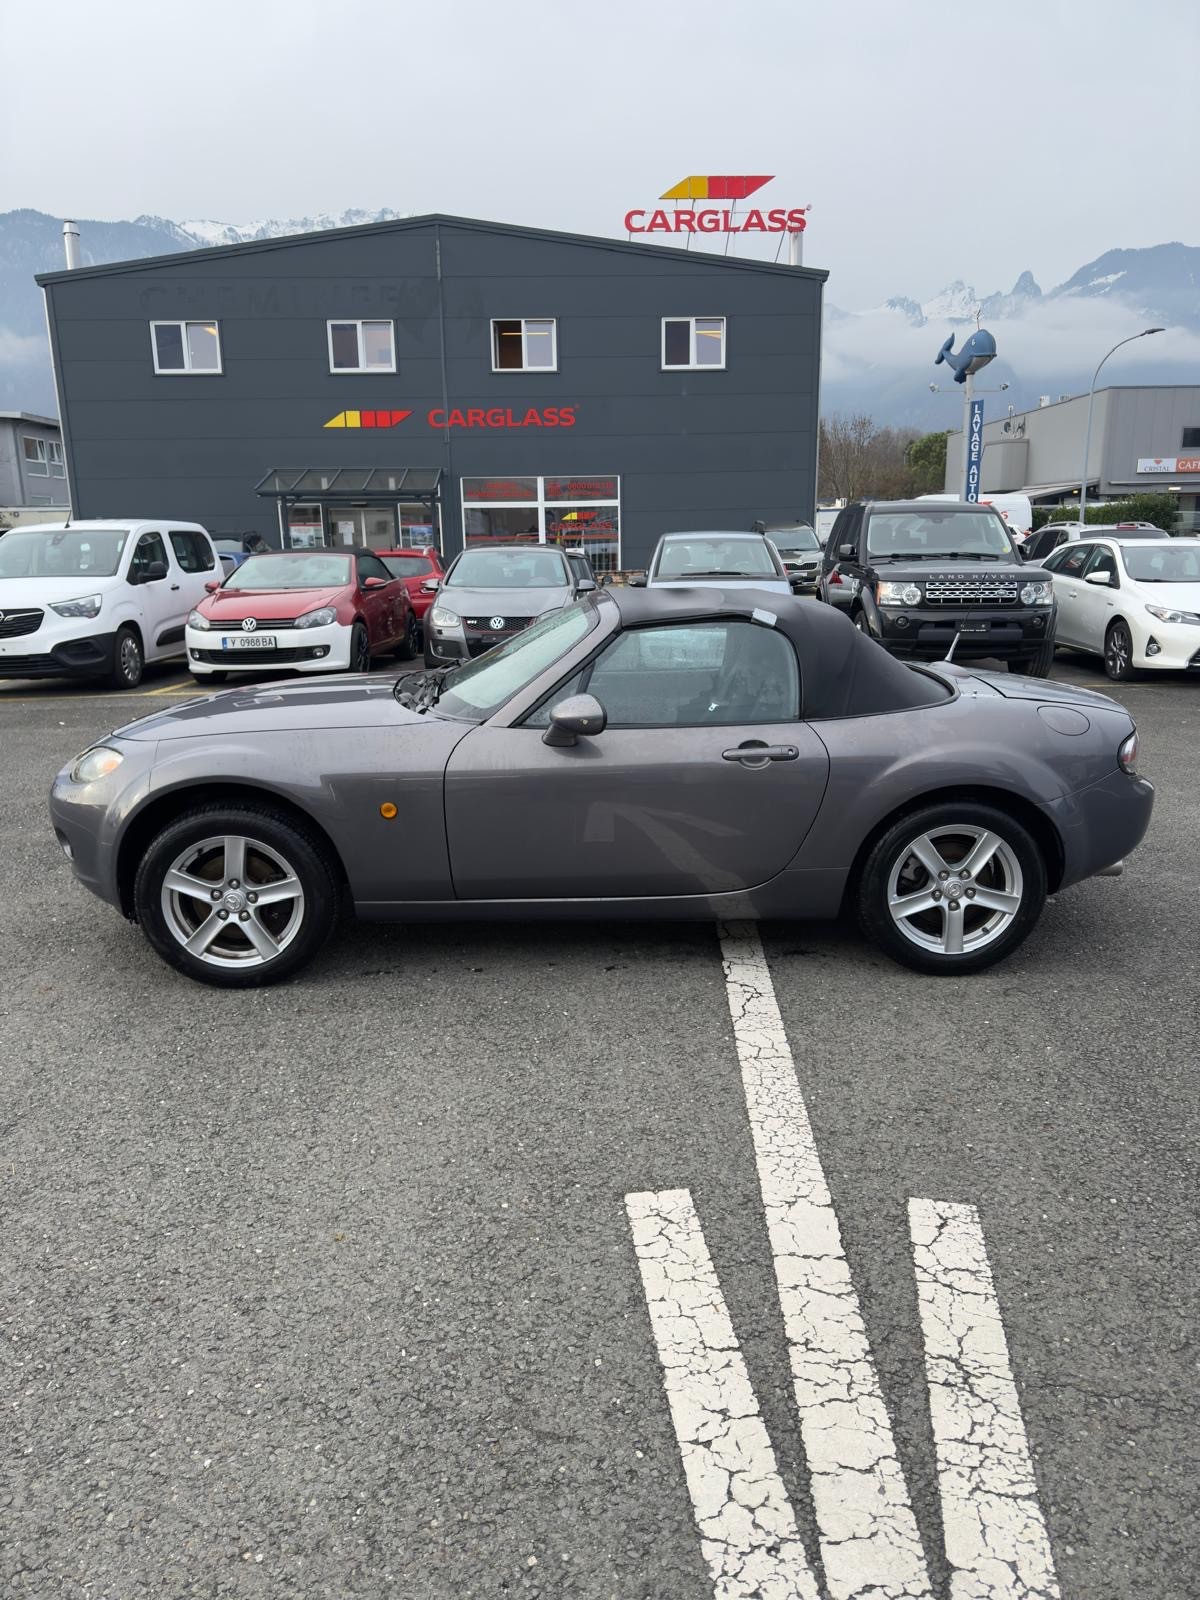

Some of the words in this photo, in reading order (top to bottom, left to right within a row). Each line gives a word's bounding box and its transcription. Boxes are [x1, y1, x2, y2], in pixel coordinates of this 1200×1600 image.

[625, 209, 806, 233] CARGLASS
[428, 407, 576, 428] CARGLASS
[971, 404, 981, 461] LAVAGE
[968, 465, 978, 503] AUTO
[240, 638, 260, 647] 0988
[261, 638, 274, 646] BA
